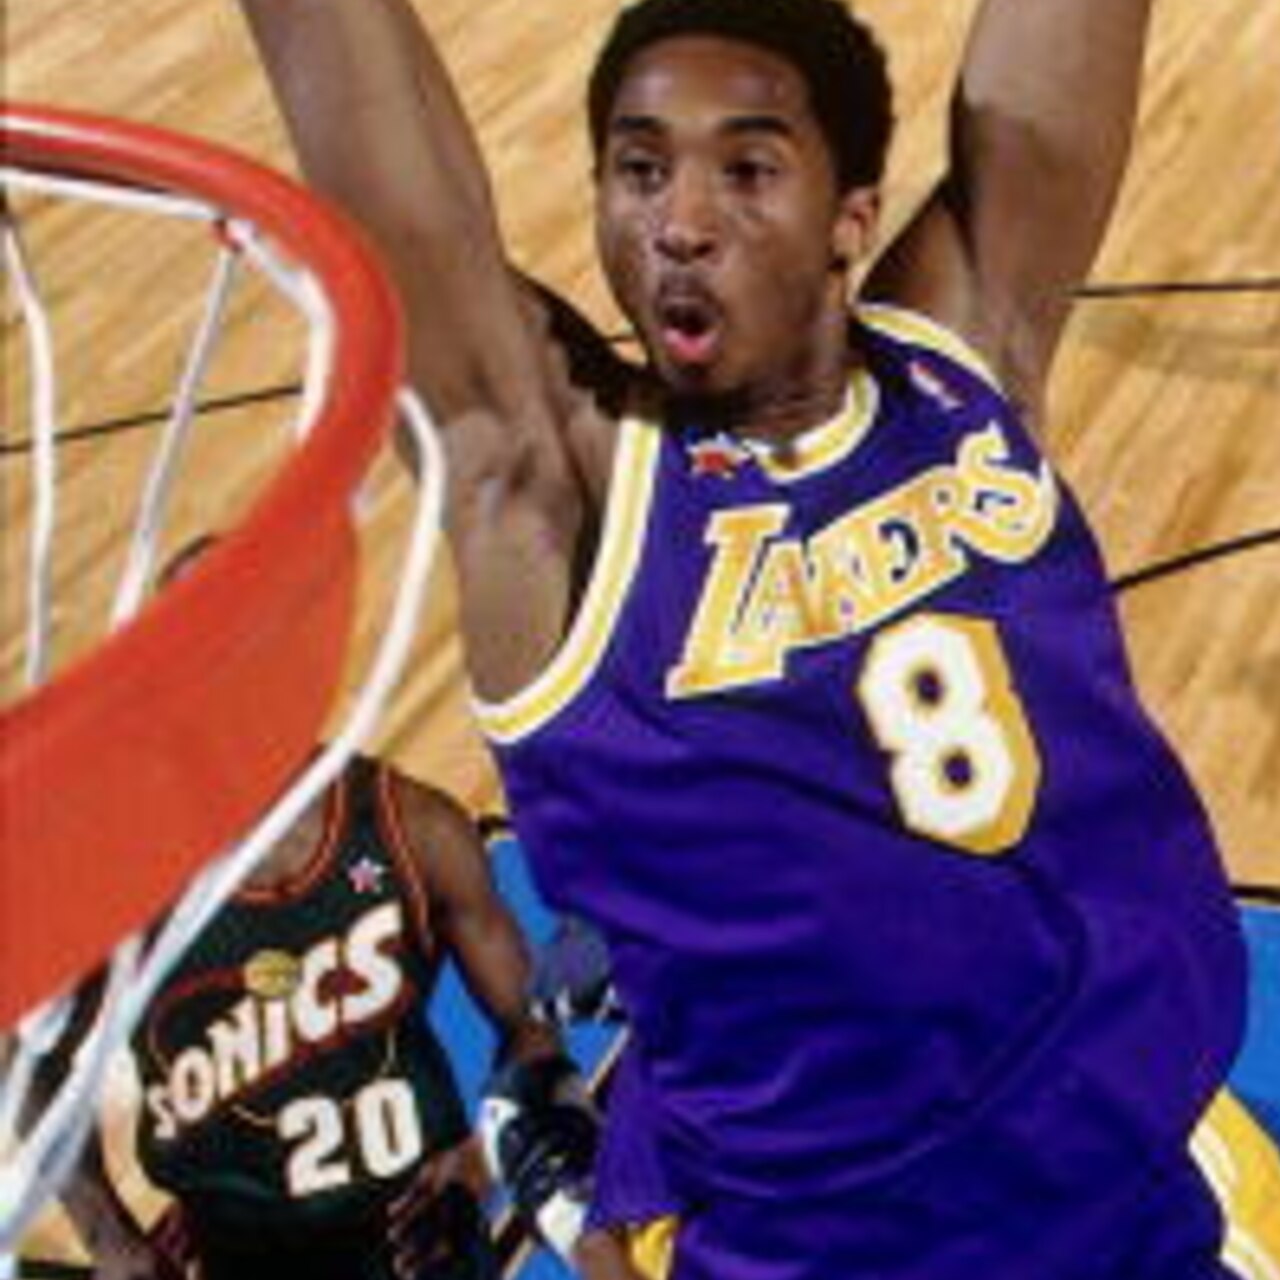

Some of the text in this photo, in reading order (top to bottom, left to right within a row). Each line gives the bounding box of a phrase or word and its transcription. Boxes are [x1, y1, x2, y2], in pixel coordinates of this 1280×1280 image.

[665, 420, 1060, 700] LAKERS
[856, 612, 1042, 856] 8
[144, 902, 403, 1141] SONICS
[276, 1078, 423, 1198] 20
